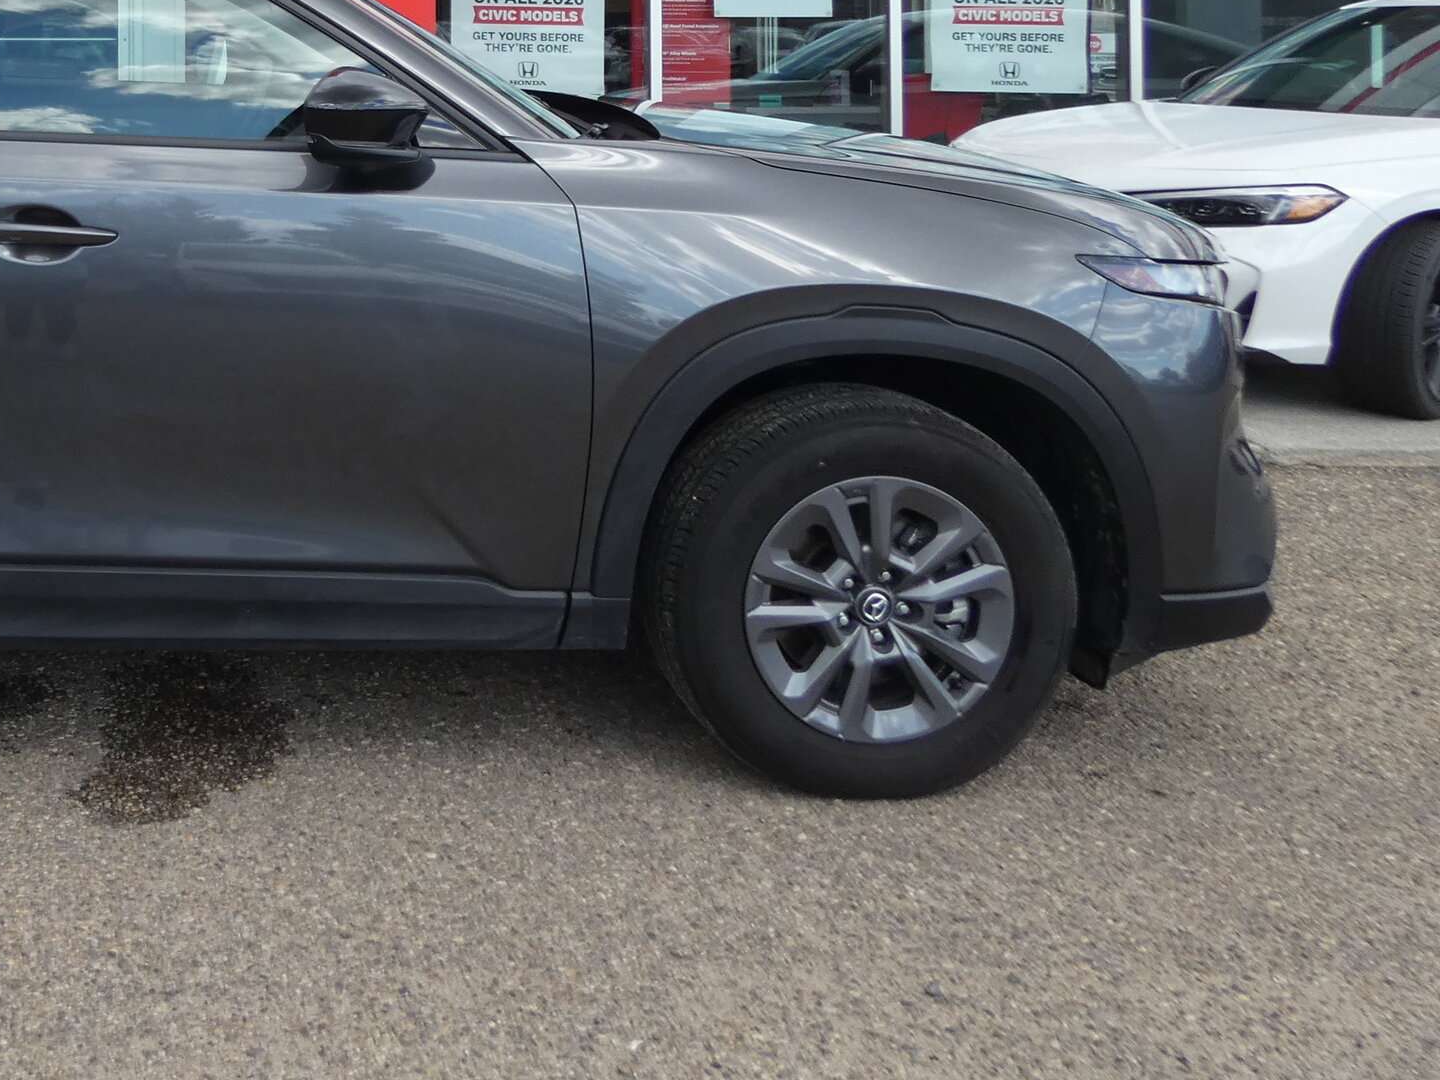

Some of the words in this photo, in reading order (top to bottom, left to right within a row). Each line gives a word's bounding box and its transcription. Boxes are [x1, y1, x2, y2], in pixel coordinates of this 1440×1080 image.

[478, 9, 517, 21] CIVIC
[520, 10, 579, 22] MODELS
[958, 9, 997, 21] CIVIC
[1000, 10, 1058, 22] MODELS
[472, 31, 495, 41] GET
[498, 32, 537, 41] YOURS
[540, 33, 584, 43] BEFORE
[952, 32, 975, 41] GET
[978, 32, 1017, 41] YOURS
[1020, 33, 1064, 42] BEFORE
[485, 43, 533, 53] THEY'RE
[537, 44, 572, 54] GONE.
[964, 43, 1013, 53] THEY'RE
[1017, 44, 1053, 54] GONE.
